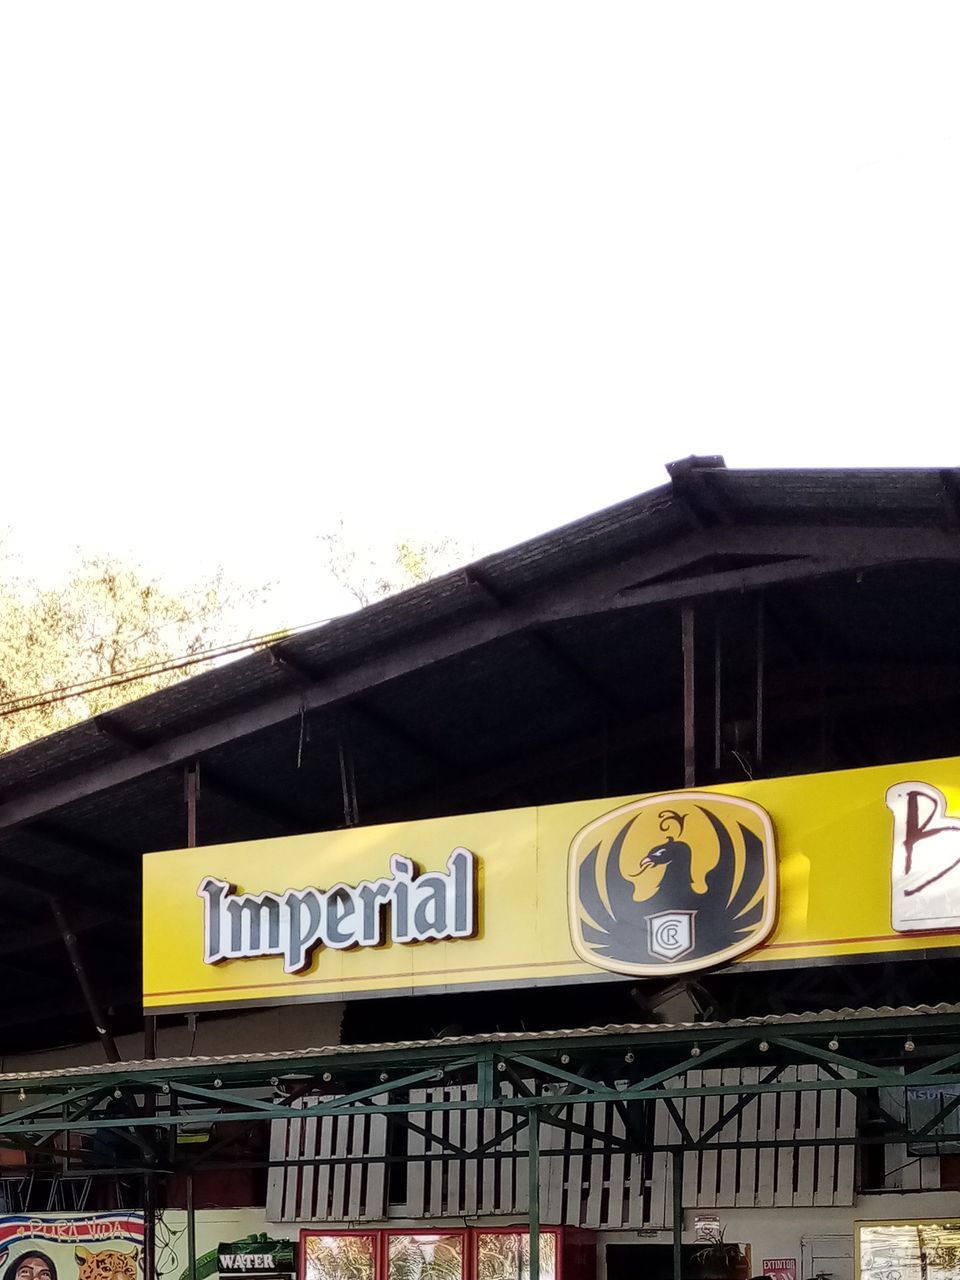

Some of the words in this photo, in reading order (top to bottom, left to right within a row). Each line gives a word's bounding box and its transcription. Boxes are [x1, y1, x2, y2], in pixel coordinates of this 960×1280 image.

[200, 850, 470, 970] Imperial
[29, 1218, 80, 1243] PURA
[219, 1253, 276, 1270] WATER
[763, 1259, 796, 1270] EXTINTOR
